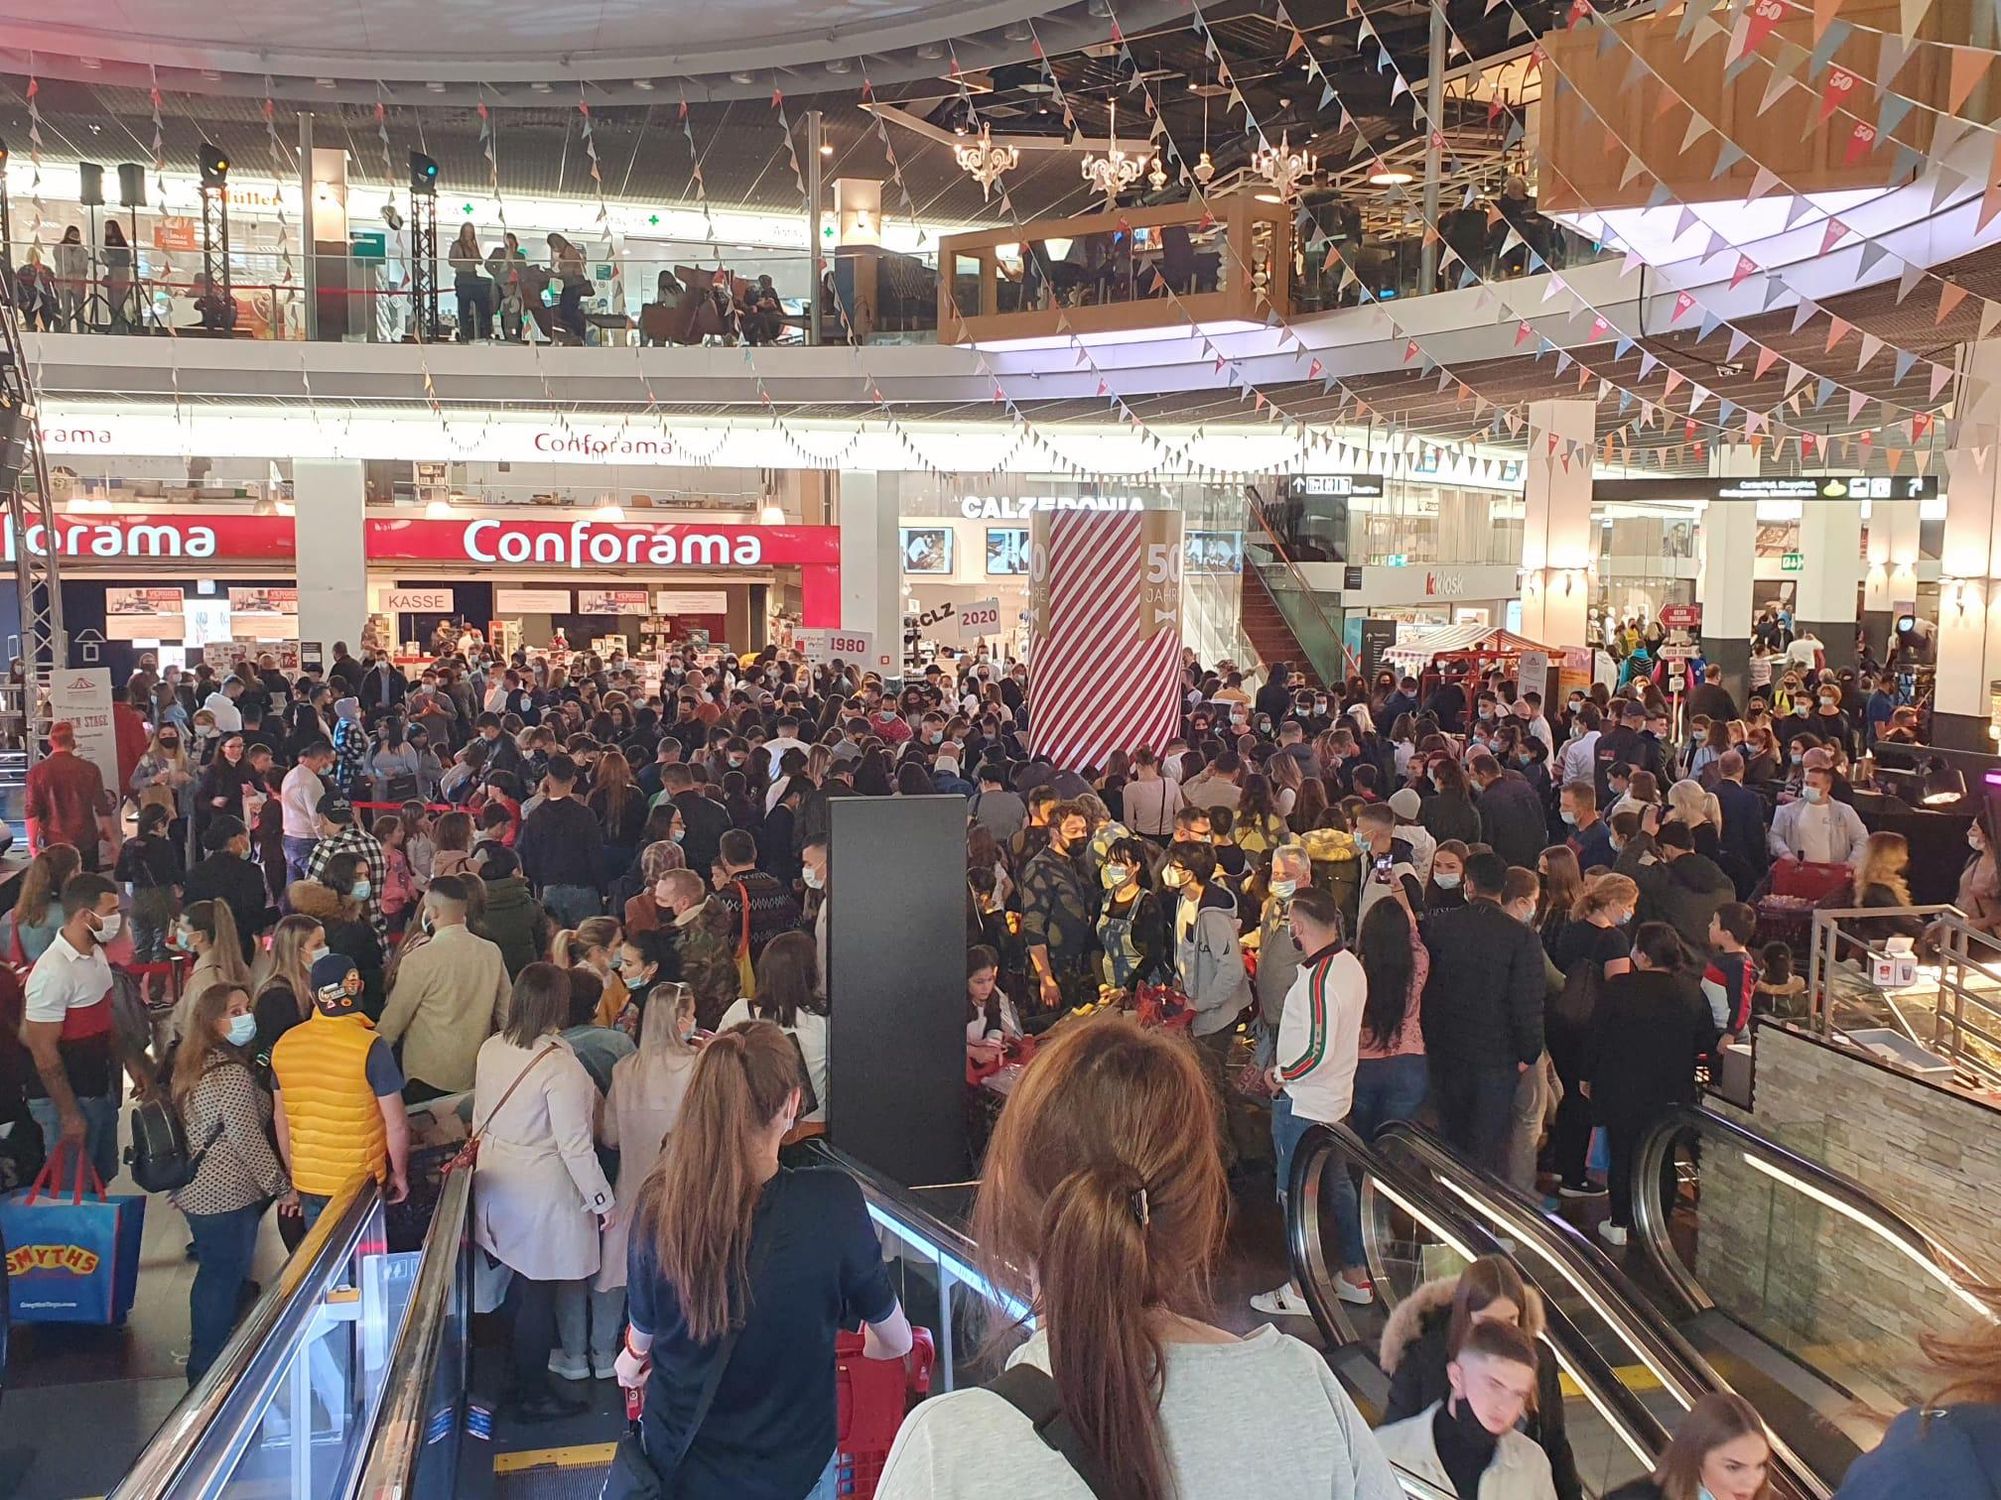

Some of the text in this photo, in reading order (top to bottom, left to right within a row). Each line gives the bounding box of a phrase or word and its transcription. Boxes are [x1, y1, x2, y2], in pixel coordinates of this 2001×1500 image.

[1756, 0, 1782, 21] 50
[1829, 71, 1853, 91] 50
[1854, 124, 1874, 142] 50
[1829, 220, 1846, 236] 50
[1739, 257, 1754, 271] 50
[1677, 294, 1691, 307] 50
[1914, 413, 1928, 424] 50
[534, 432, 672, 455] Conforama
[1803, 433, 1814, 443] 50
[463, 519, 761, 568] Conforama
[1032, 543, 1047, 583] 0
[1146, 543, 1180, 584] 50
[388, 594, 446, 609] KASSE
[961, 609, 998, 626] 2020
[830, 637, 866, 653] 1980
[84, 714, 109, 728] STAGE
[6, 1247, 97, 1273] SMYTHS
